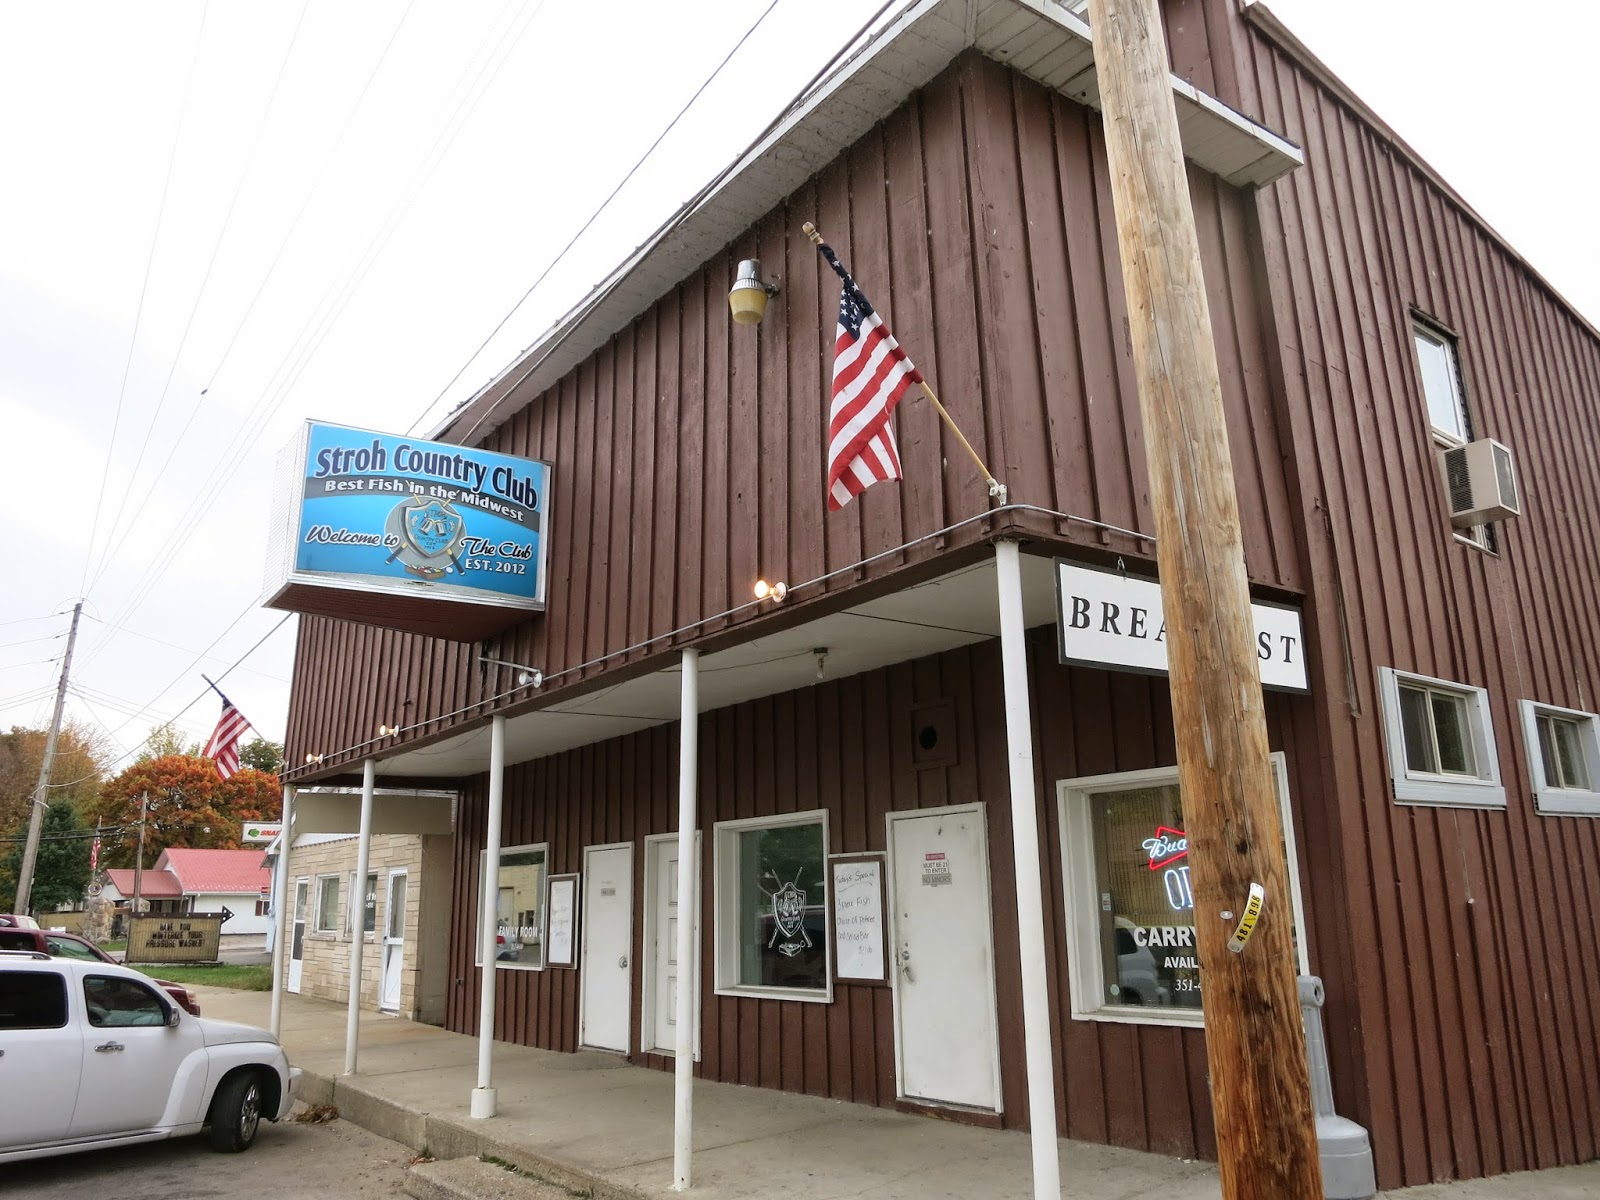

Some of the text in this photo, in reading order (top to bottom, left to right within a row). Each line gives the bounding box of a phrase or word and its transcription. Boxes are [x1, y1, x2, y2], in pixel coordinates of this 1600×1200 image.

[315, 439, 538, 510] Stroh Country Club
[325, 478, 525, 523] Best Fish in the Midwest
[305, 525, 399, 548] Welcome to
[460, 536, 533, 561] The Club
[465, 558, 526, 575] EST. 2012
[1069, 595, 1296, 664] BREST
[923, 875, 951, 884] NO MINORS
[856, 896, 871, 907] Fish
[498, 925, 538, 938] FAMILY ROOM
[145, 939, 176, 948] PRESSURE
